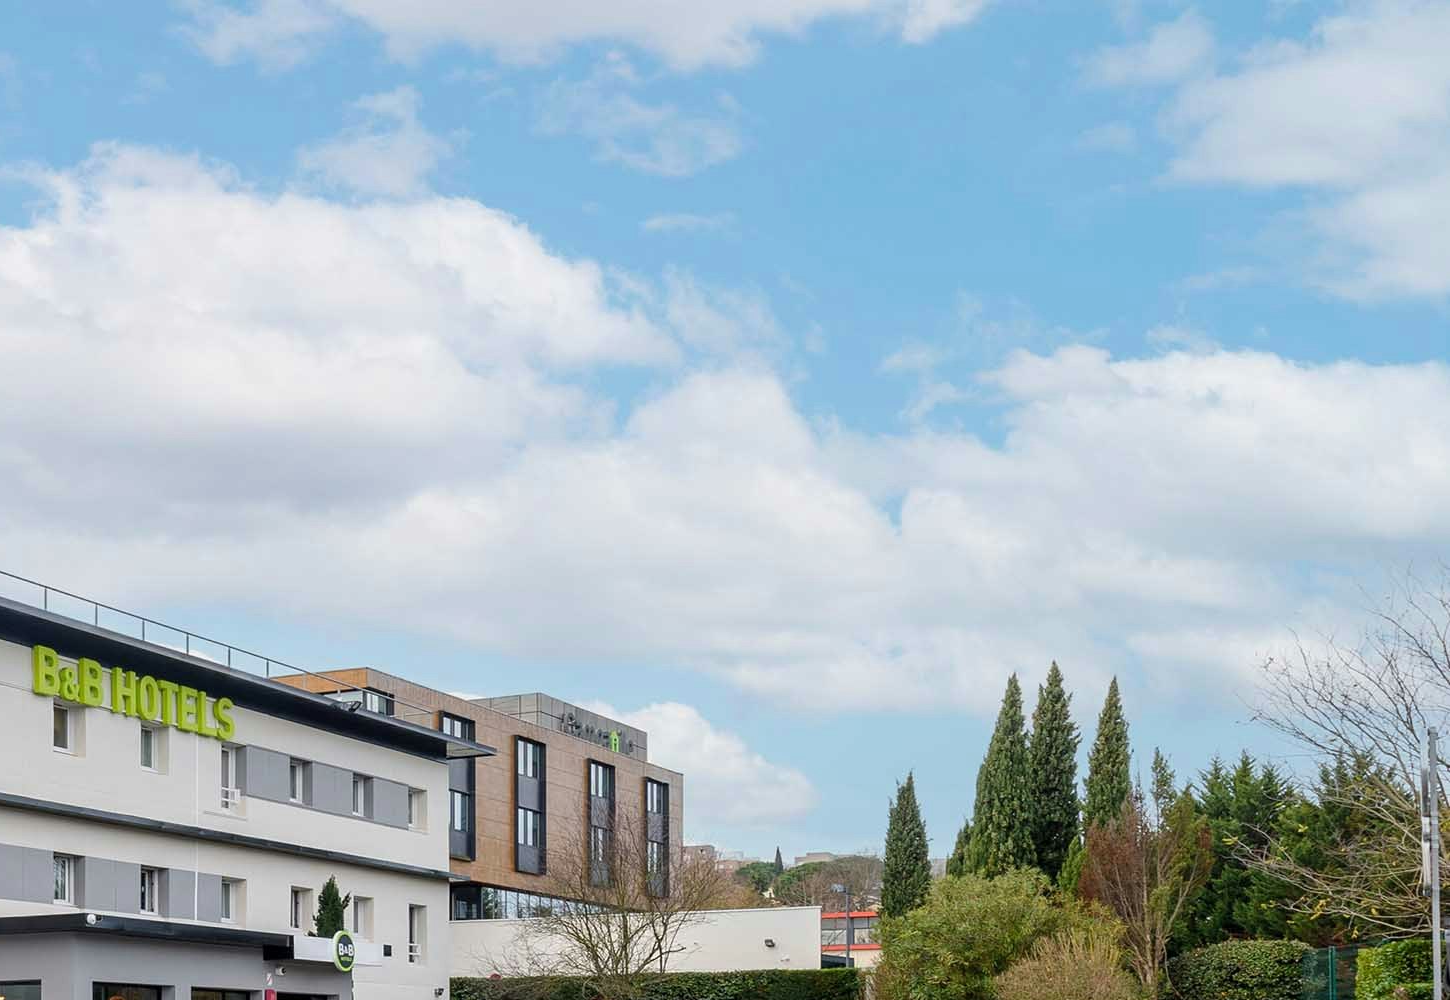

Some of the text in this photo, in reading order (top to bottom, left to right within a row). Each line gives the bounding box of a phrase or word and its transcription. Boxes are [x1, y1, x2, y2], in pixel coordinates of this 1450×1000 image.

[32, 644, 236, 742] B&B HOTELS
[339, 943, 354, 956] B&B
